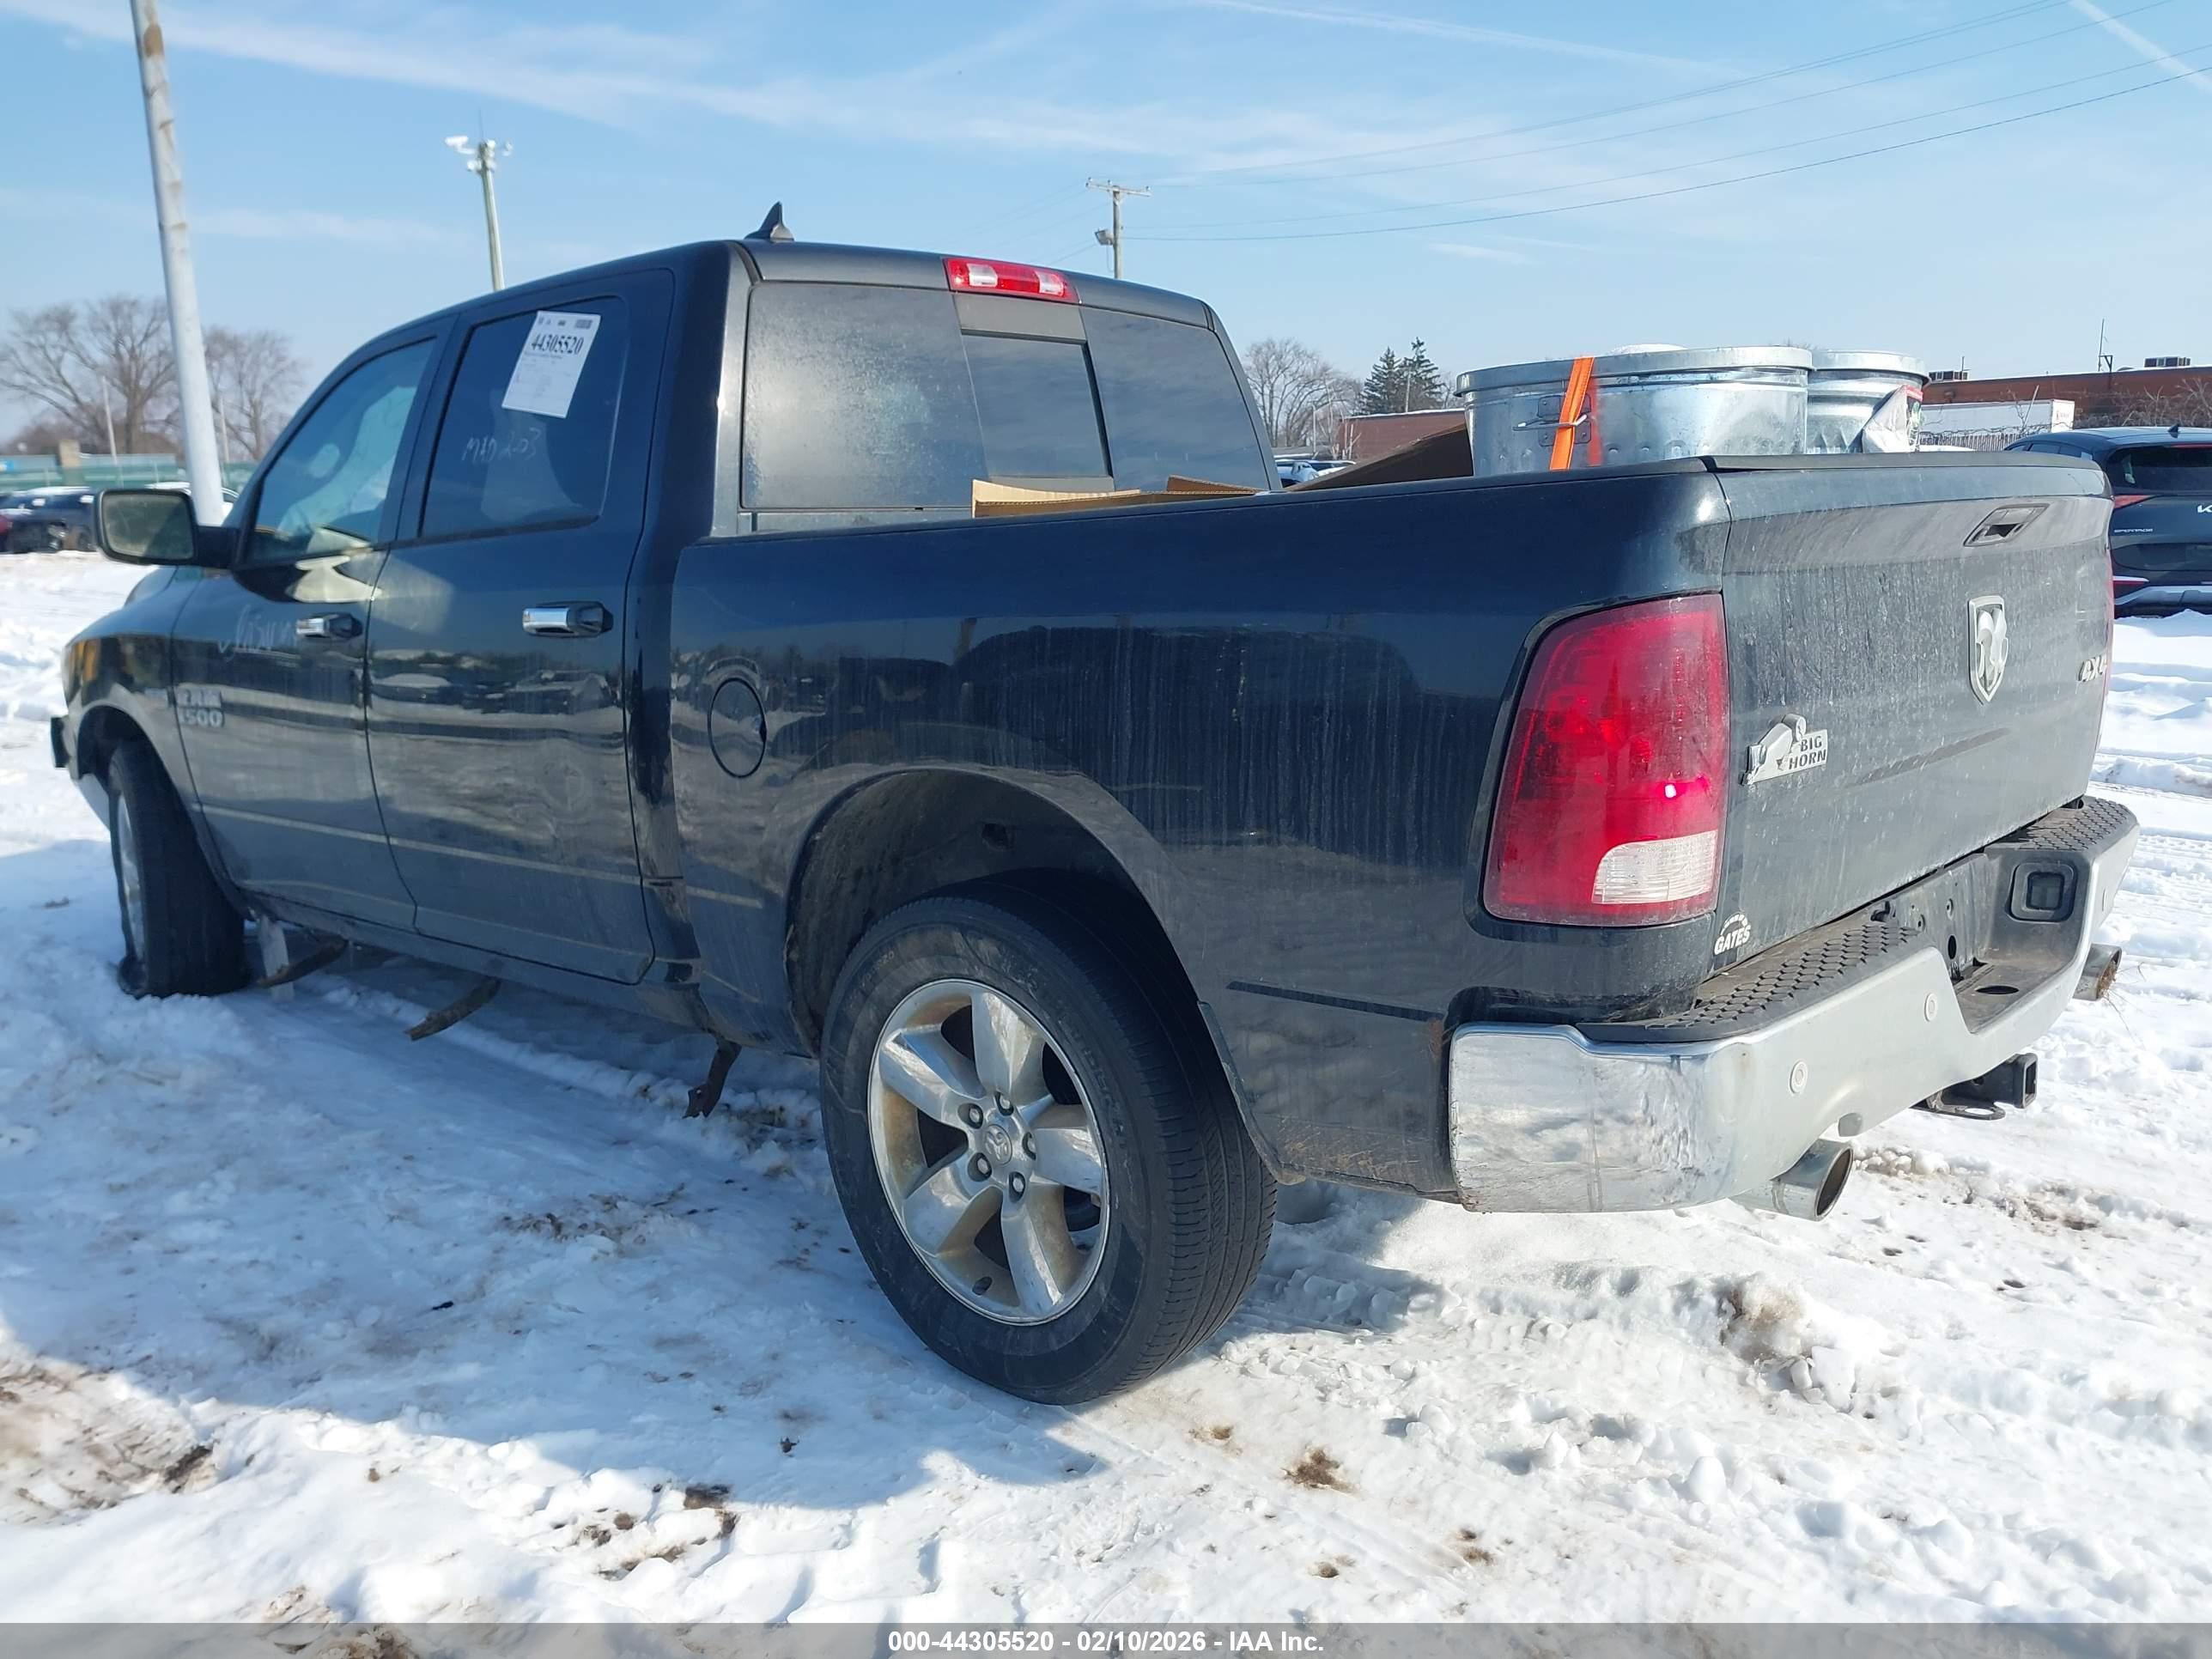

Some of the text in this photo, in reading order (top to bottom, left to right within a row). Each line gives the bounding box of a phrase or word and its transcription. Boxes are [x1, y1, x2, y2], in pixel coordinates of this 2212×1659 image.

[531, 333, 585, 355] 44305520
[177, 708, 225, 728] 1500
[1800, 735, 1822, 752] BIG
[1789, 750, 1826, 770] HORN
[1714, 924, 1752, 956] GATES
